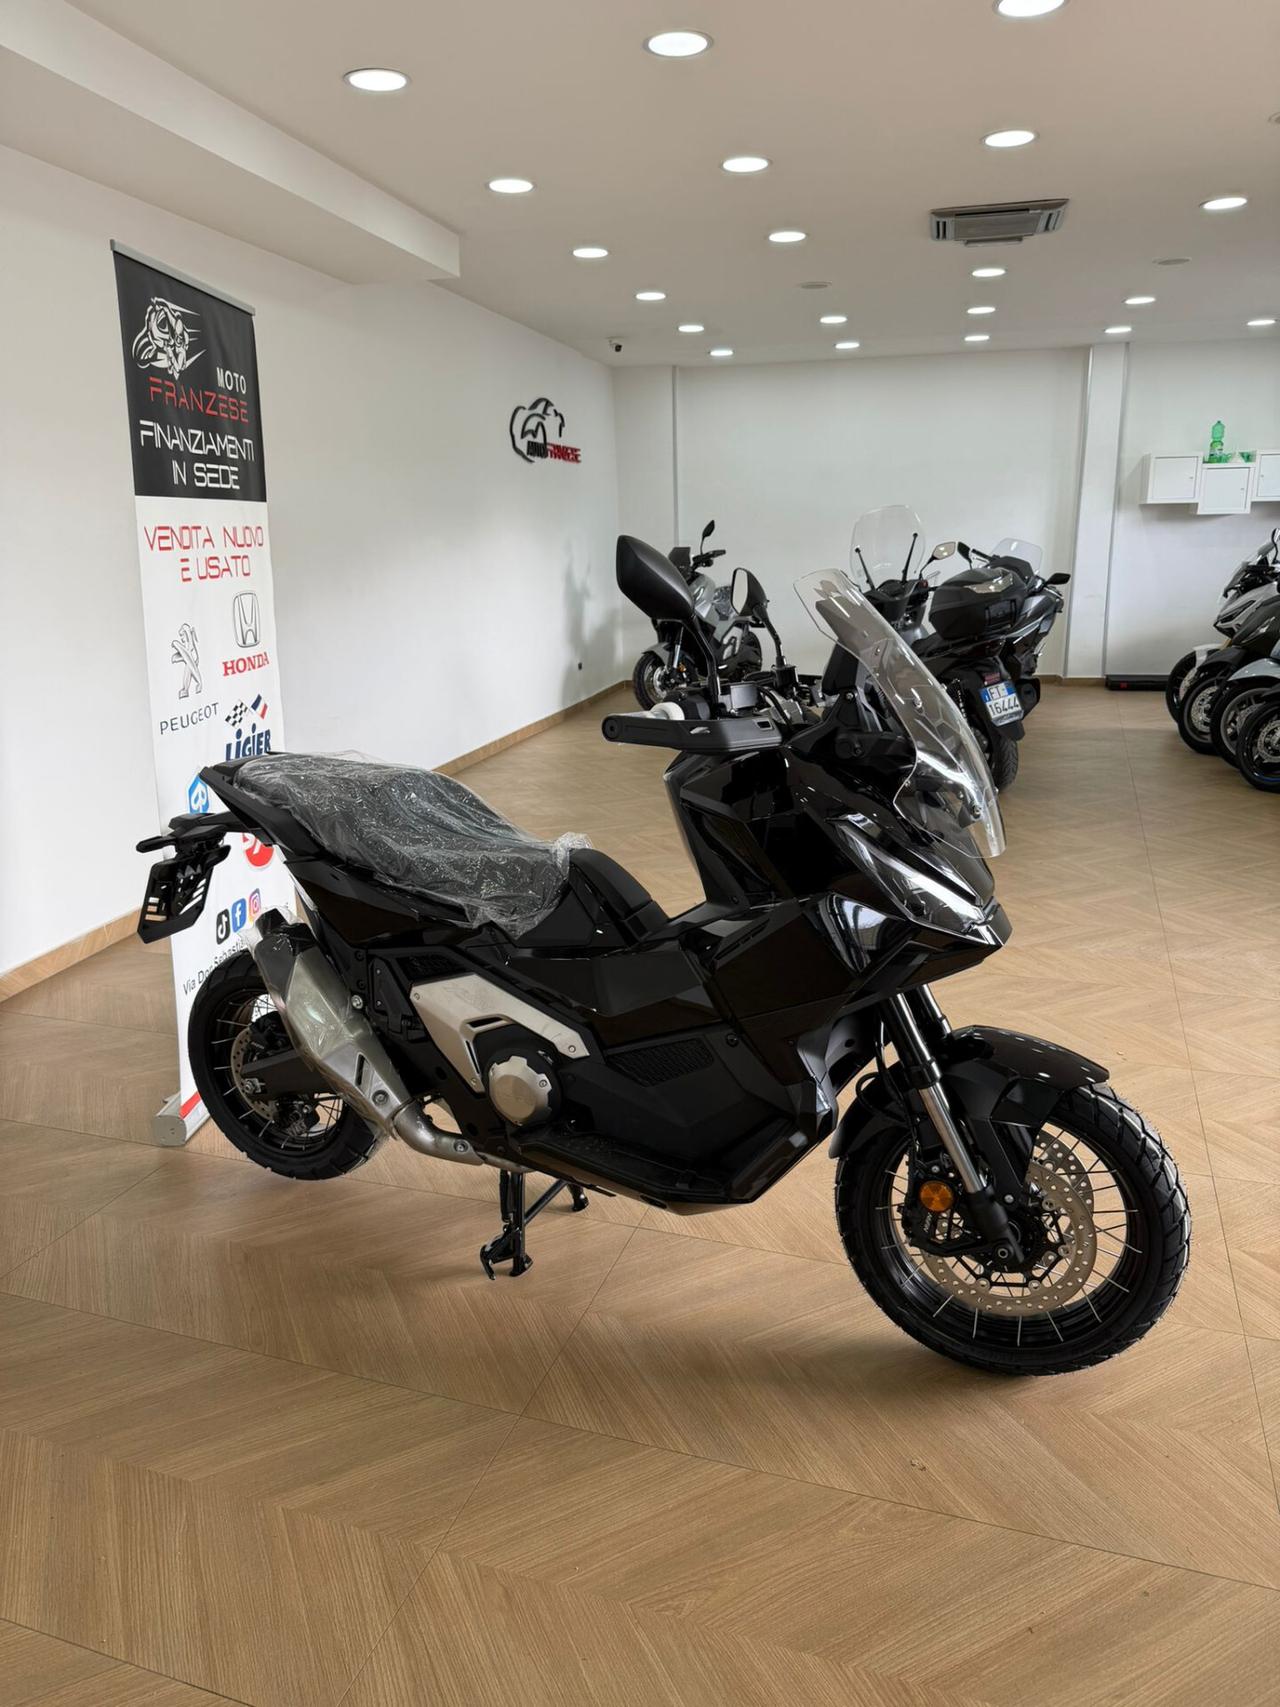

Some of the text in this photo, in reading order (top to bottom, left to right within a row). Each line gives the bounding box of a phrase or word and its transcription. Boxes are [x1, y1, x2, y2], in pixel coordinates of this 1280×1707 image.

[217, 367, 246, 394] MOTO
[149, 377, 249, 423] FRANZESE
[140, 419, 255, 462] FINANZIAMENTI
[172, 459, 240, 490] IN SEDE
[144, 525, 264, 551] VENDITA NUOVO
[180, 554, 251, 582] E USATO
[222, 652, 269, 676] HONDA
[160, 702, 219, 735] PEUGEOT
[989, 696, 1019, 716] 16444
[183, 977, 196, 995] Via
